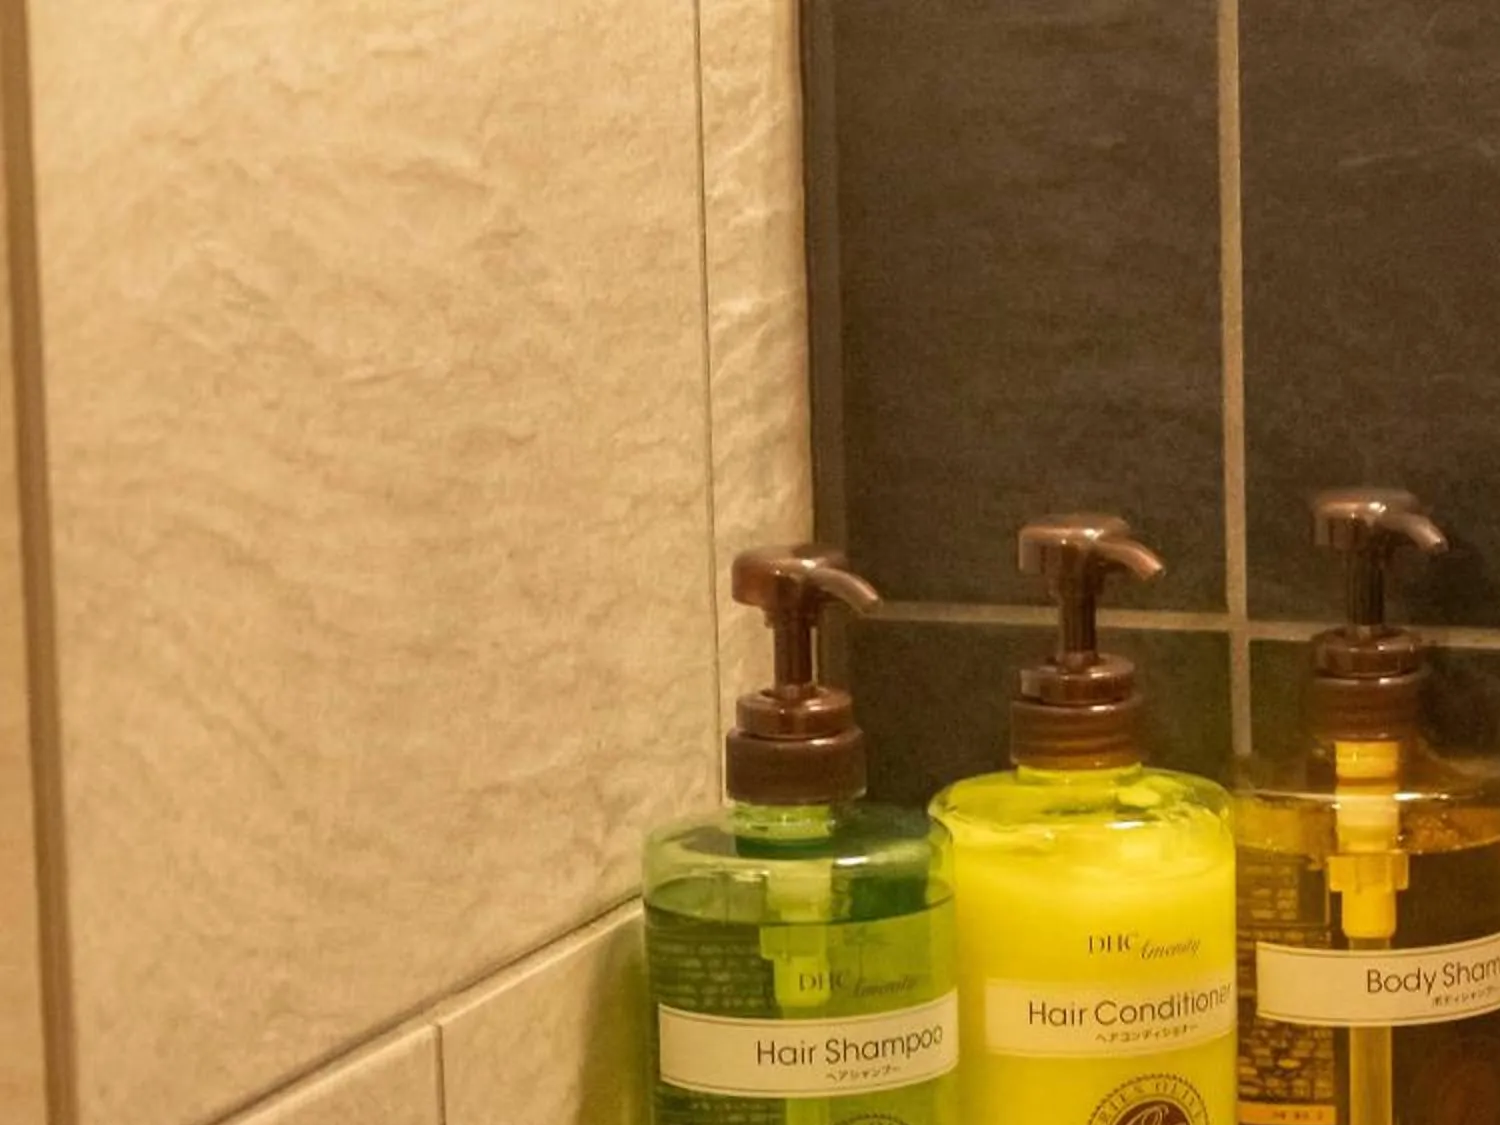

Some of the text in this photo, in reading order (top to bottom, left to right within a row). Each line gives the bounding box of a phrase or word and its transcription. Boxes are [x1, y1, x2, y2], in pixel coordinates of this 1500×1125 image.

[1088, 931, 1140, 954] DHC
[1366, 966, 1437, 996] Body
[1028, 983, 1233, 1028] Hair Conditioner
[756, 1023, 944, 1066] Hair Shampoo
